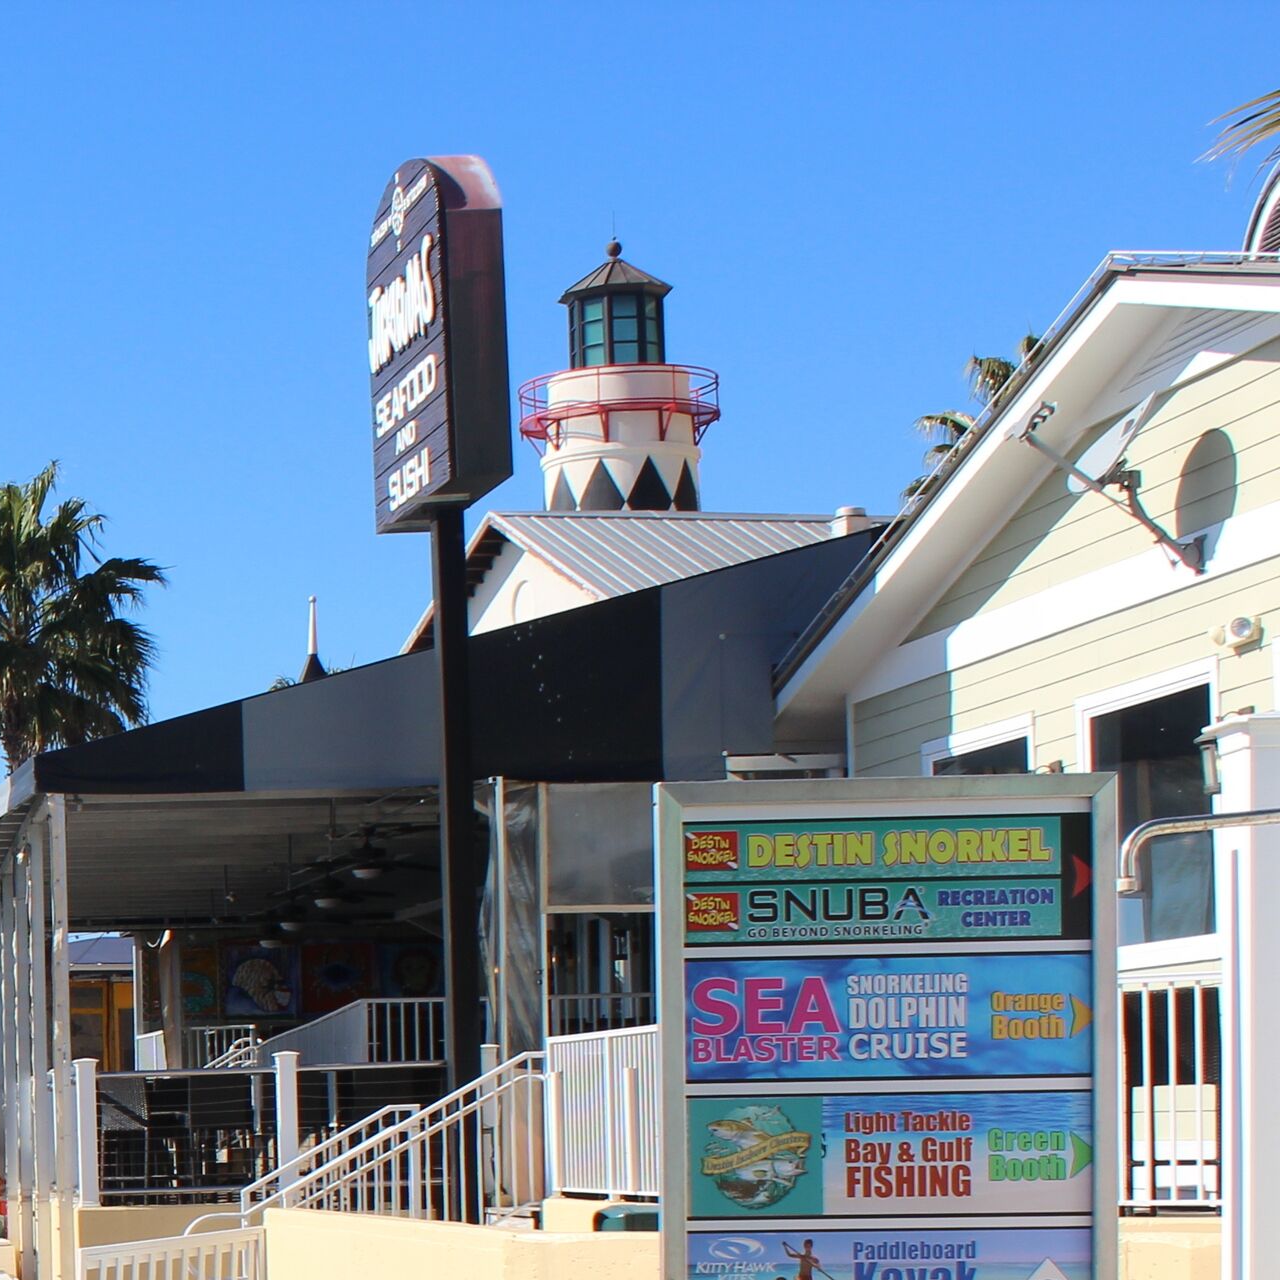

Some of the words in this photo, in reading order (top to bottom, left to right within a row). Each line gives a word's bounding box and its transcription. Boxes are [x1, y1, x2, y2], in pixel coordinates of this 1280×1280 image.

[375, 354, 437, 438] SEAFOOD
[396, 419, 417, 455] AND
[388, 446, 431, 512] SUSHI
[692, 835, 729, 849] DESTIN
[746, 831, 875, 872] DESTIN
[881, 828, 1053, 867] SNORKEL
[687, 849, 736, 864] SNORKEL
[692, 896, 730, 910] DESTIN
[938, 888, 1054, 908] RECREATION
[688, 911, 737, 925] SNORKEL
[961, 910, 1032, 929] CENTER
[747, 927, 768, 938] GO
[772, 926, 829, 938] BEYOND
[834, 924, 924, 937] SNORKELING
[846, 973, 968, 997] SNORKELING
[691, 976, 841, 1037] SEA
[847, 996, 967, 1029] DOLPHIN
[991, 991, 1064, 1015] Orange
[992, 1013, 1064, 1040] Booth
[692, 1036, 840, 1064] BLASTER
[848, 1031, 967, 1060] CRUISE
[844, 1112, 896, 1135] Light
[900, 1111, 971, 1132] Tackle
[988, 1128, 1066, 1152] Green
[845, 1139, 891, 1168] Bay
[900, 1140, 915, 1163] &
[921, 1137, 972, 1163] Gulf
[988, 1154, 1067, 1182] Booth
[846, 1165, 972, 1198] FISHING
[853, 1241, 977, 1260] Paddleboard
[695, 1261, 733, 1274] KITTY
[734, 1261, 777, 1273] HAWK
